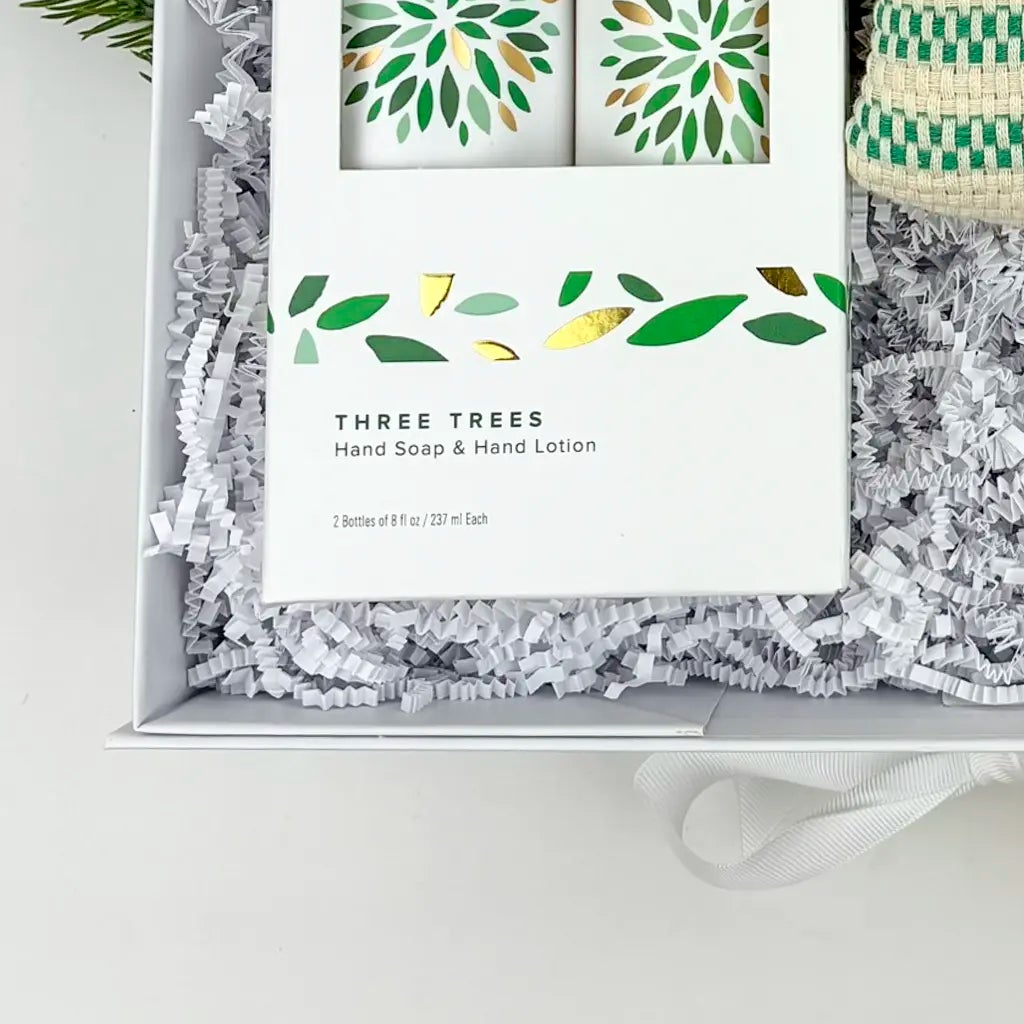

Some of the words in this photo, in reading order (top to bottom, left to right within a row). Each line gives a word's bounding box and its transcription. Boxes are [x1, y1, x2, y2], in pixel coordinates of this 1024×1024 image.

[335, 413, 431, 430] THREE
[449, 411, 543, 428] TREES
[335, 441, 386, 457] Hand
[395, 440, 445, 459] Soap
[453, 440, 466, 456] &
[474, 439, 526, 455] Hand
[535, 438, 596, 454] Lotion
[333, 515, 340, 528] 2
[342, 514, 376, 528] Bottles
[378, 514, 388, 527] of
[391, 514, 397, 527] 8
[400, 513, 407, 526] fl
[410, 516, 420, 527] oz
[422, 513, 428, 528] /
[430, 513, 448, 526] 237
[451, 513, 463, 526] ml
[466, 512, 488, 526] Each
